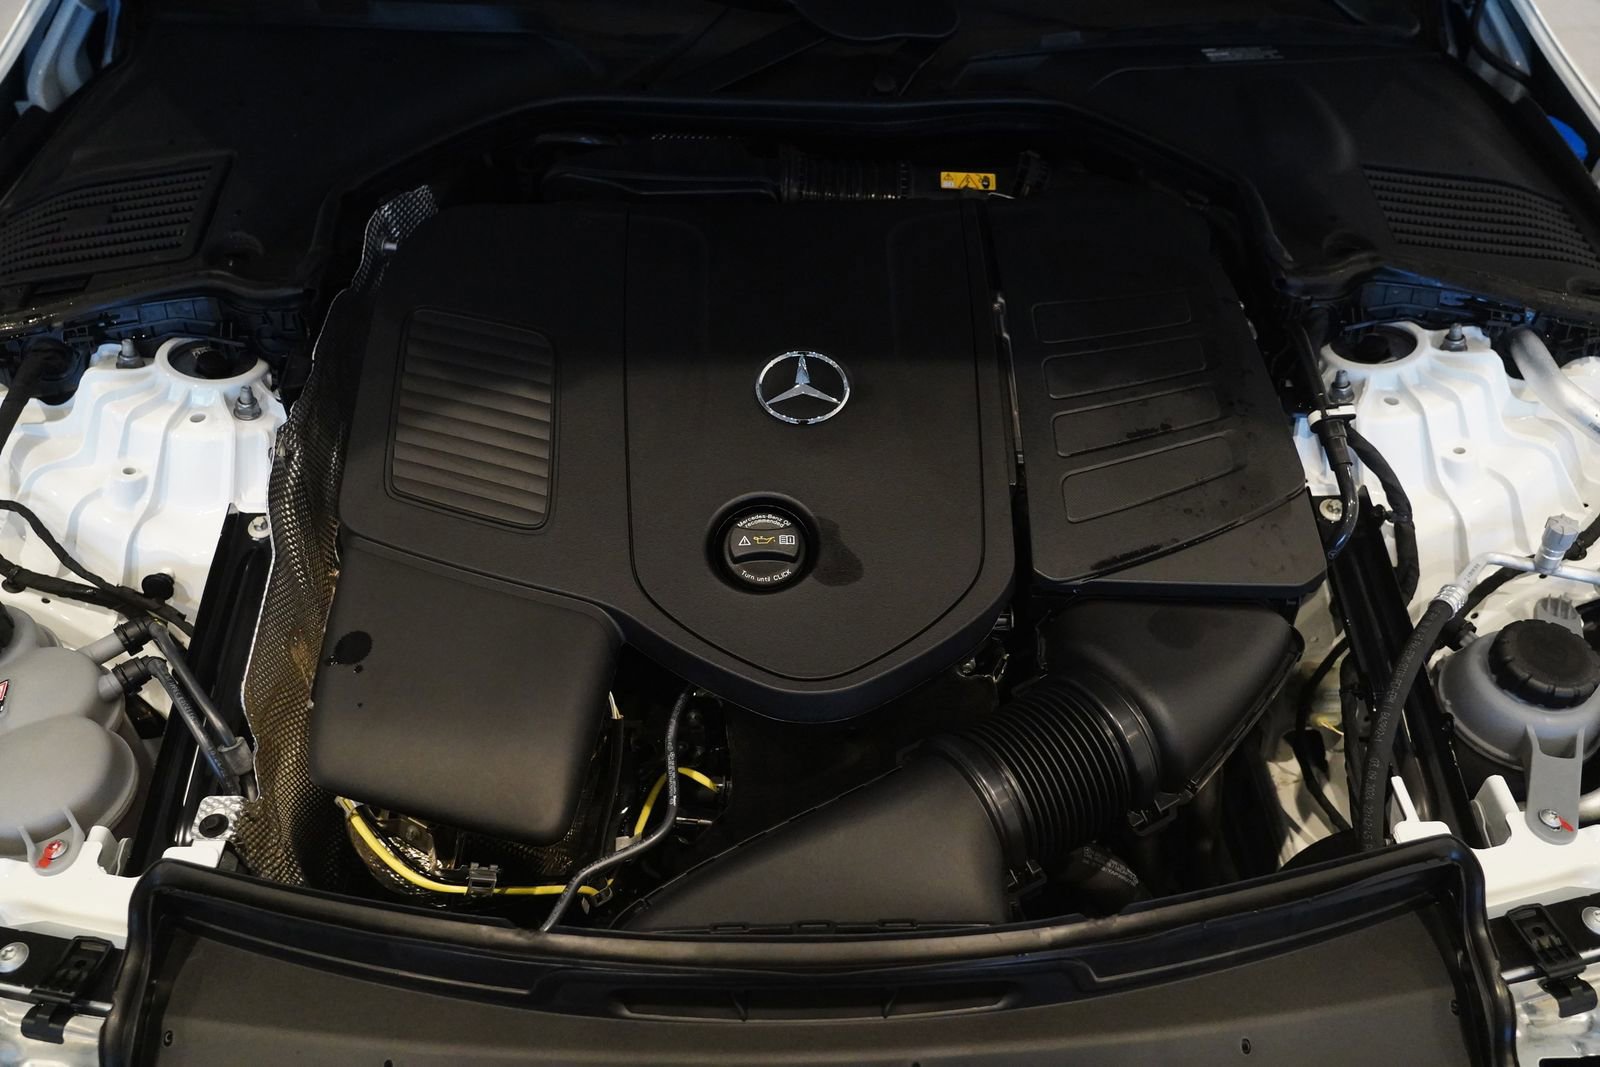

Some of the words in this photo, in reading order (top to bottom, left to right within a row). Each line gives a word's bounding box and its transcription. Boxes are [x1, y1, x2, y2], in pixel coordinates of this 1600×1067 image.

[737, 514, 783, 527] Mercedes-Benz
[745, 519, 784, 528] recommended
[741, 569, 755, 581] Turn
[756, 575, 771, 583] until
[773, 569, 792, 581] CLICK
